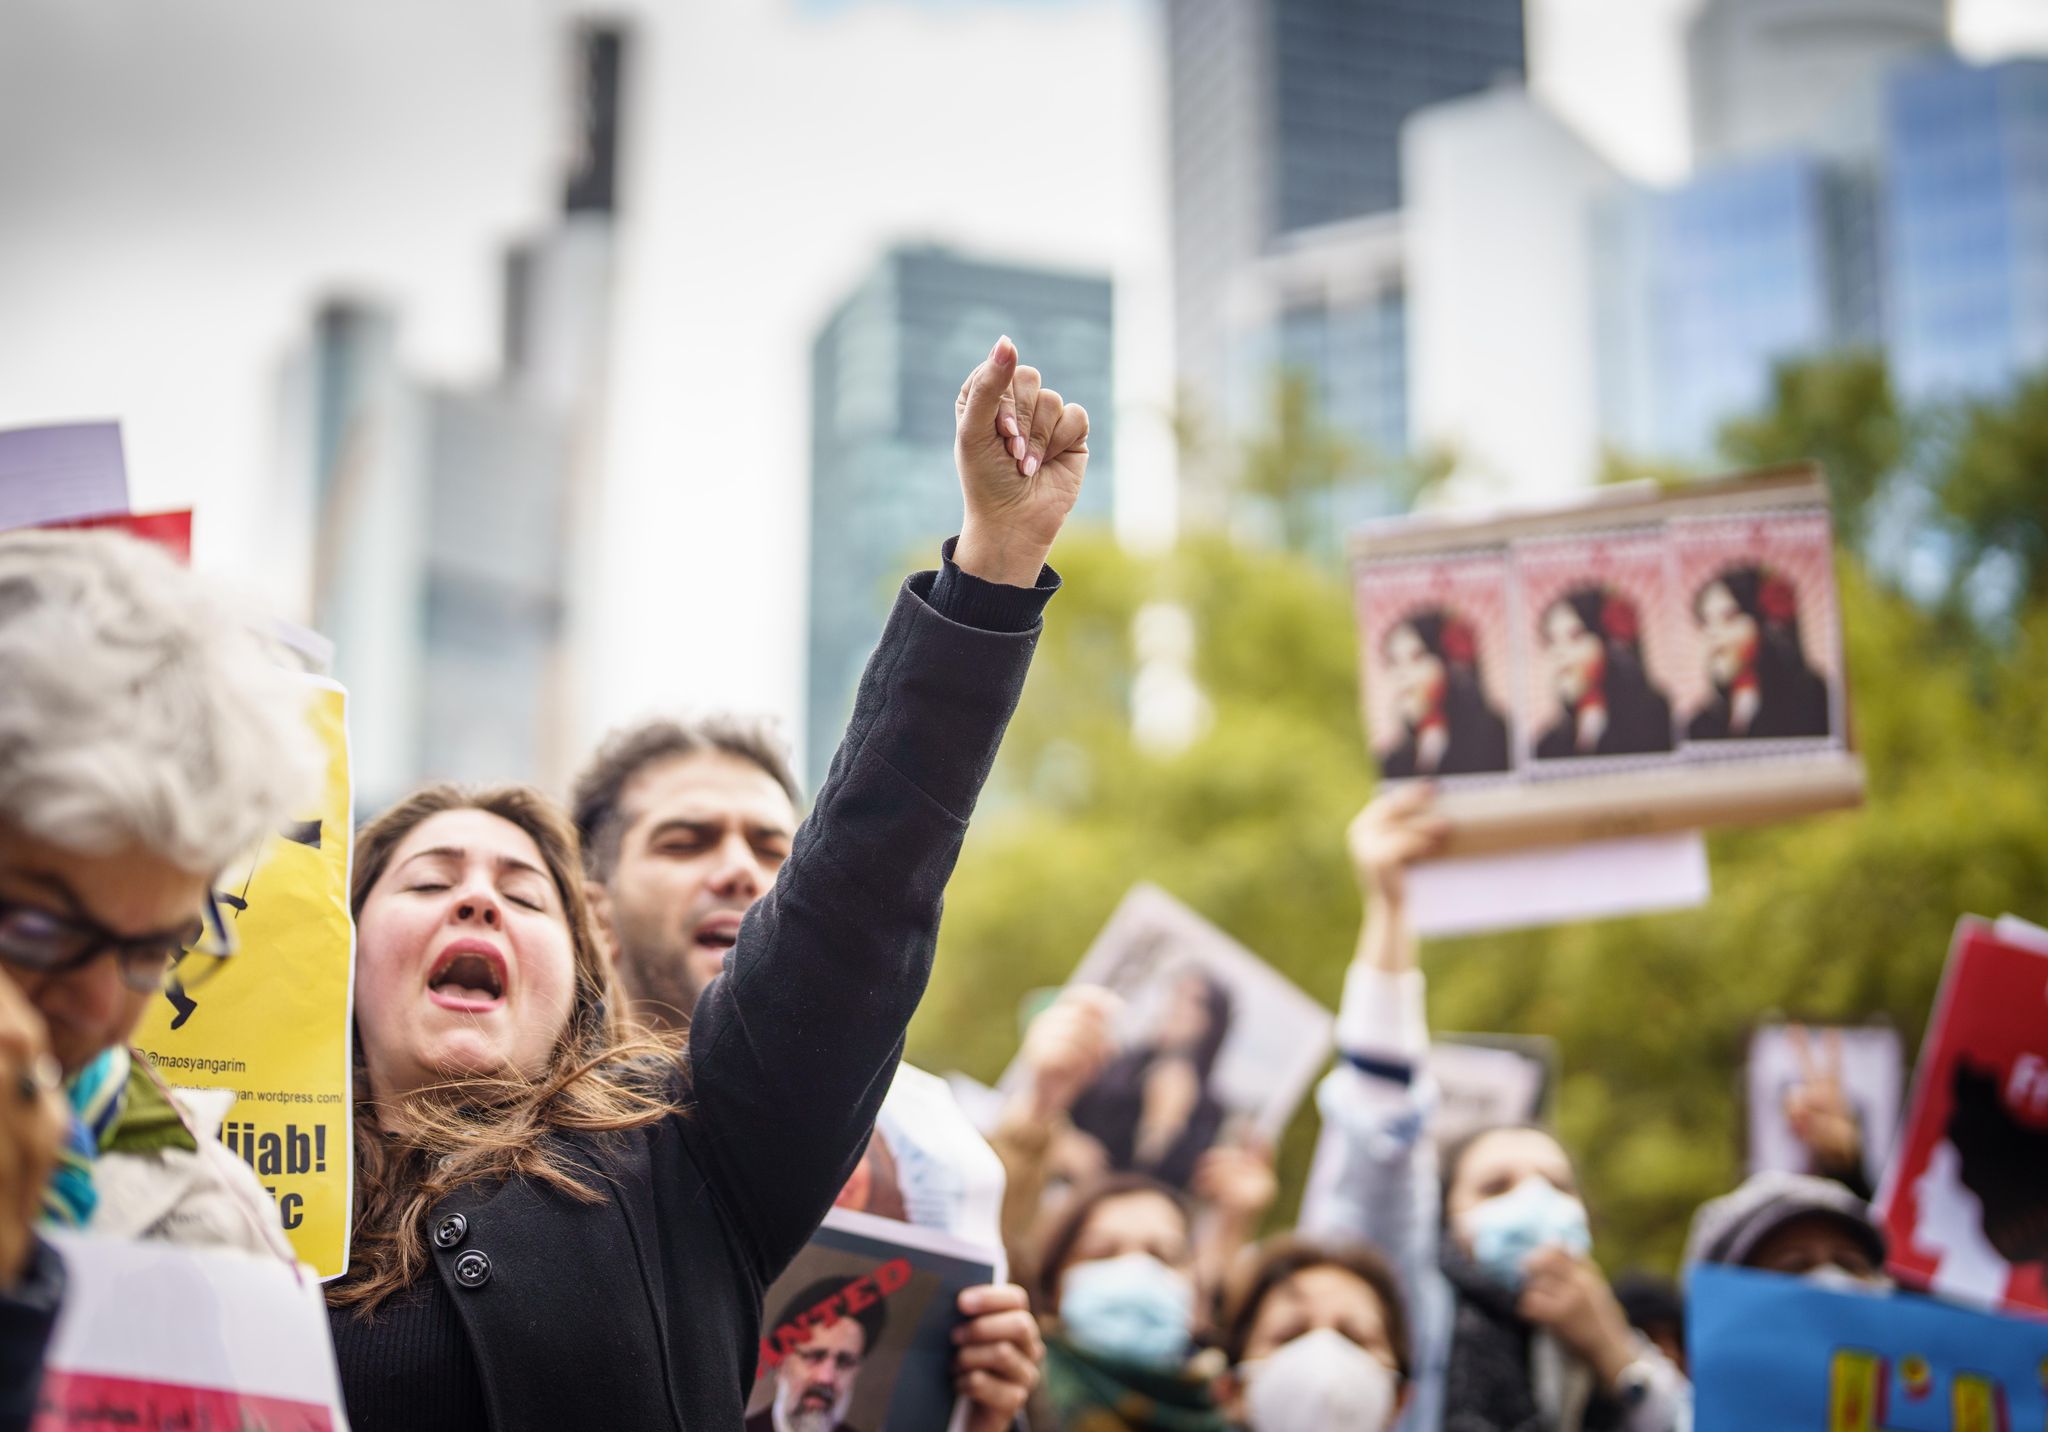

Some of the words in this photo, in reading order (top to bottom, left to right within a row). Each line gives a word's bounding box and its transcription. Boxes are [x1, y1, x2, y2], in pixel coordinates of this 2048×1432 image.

[147, 1051, 246, 1074] @maosyangarim
[217, 1122, 326, 1176] ijab!
[757, 1258, 912, 1381] ANTED
